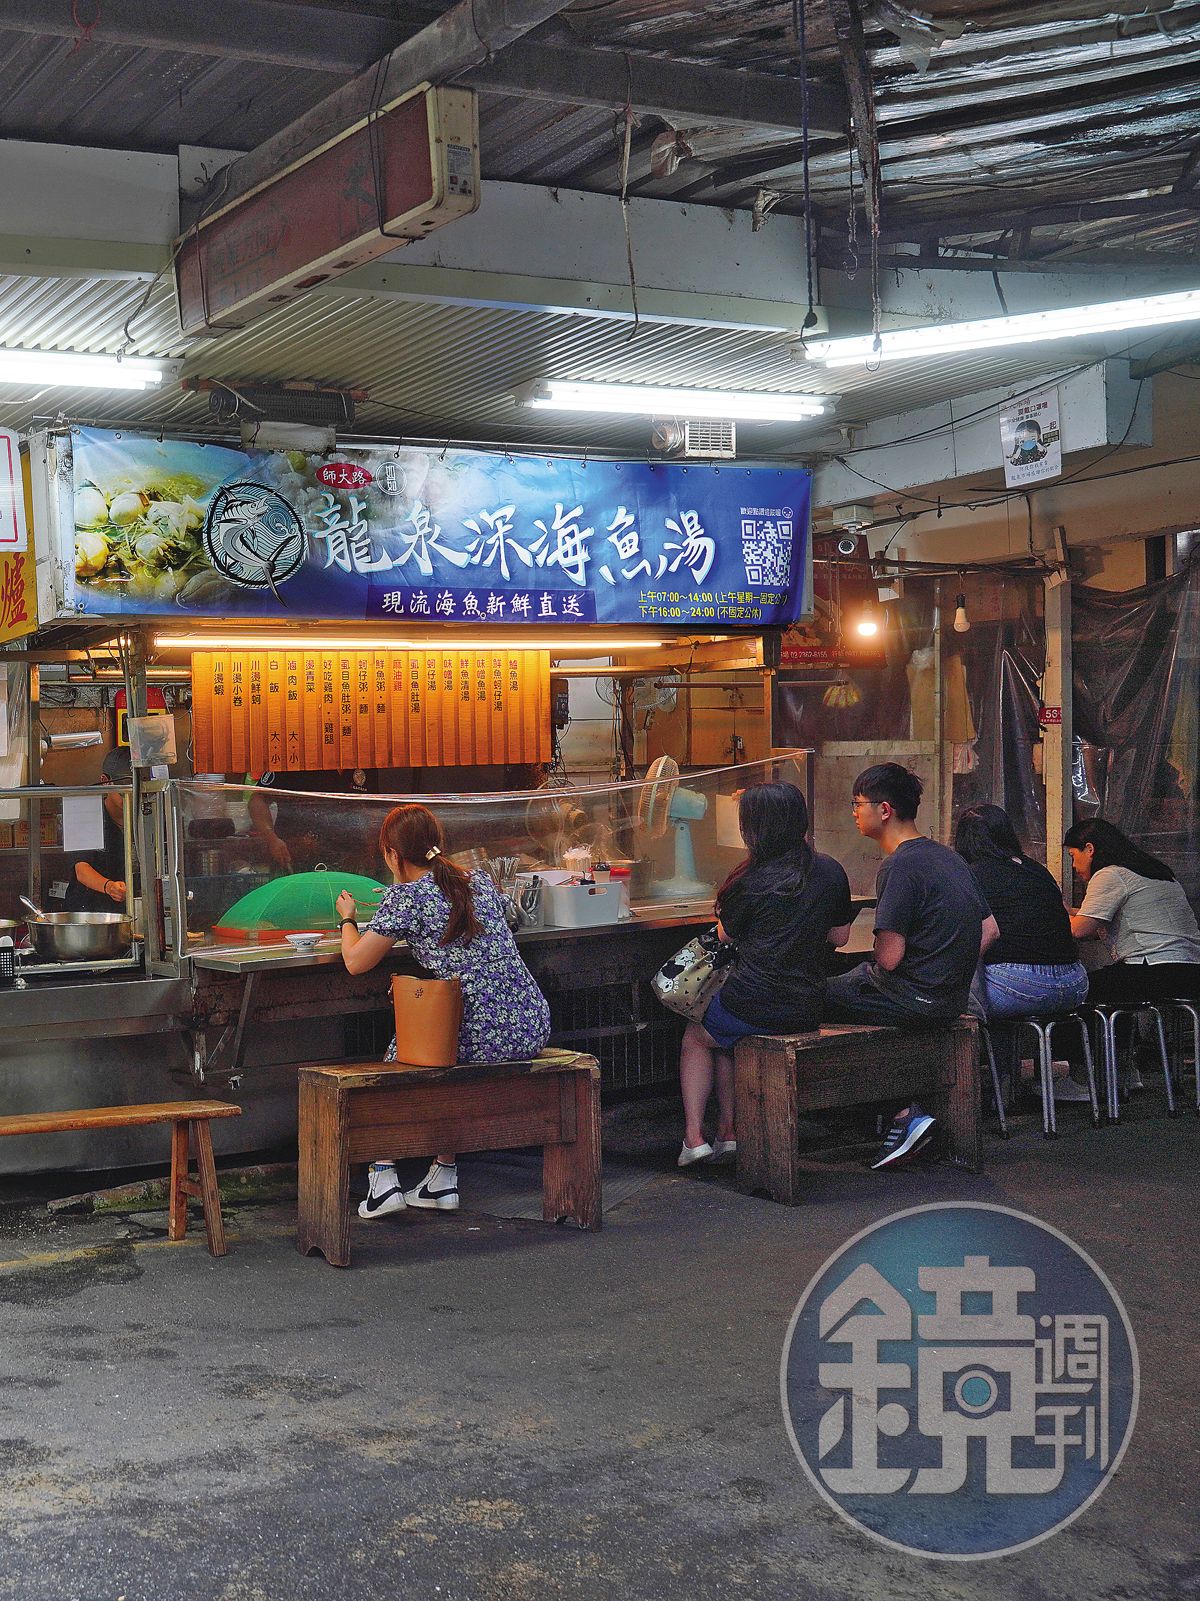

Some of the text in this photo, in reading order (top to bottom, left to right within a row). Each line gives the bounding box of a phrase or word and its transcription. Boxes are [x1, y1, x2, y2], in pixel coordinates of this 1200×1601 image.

[322, 468, 367, 485] 師大路
[312, 491, 716, 586] 龍泉深海魚湯
[381, 589, 585, 617] 現流海魚新鮮直送
[214, 661, 225, 696] 川燙蝦
[232, 661, 243, 707] 川燙小卷
[250, 660, 261, 705] 川燙鮮蚵
[269, 660, 279, 693] 白飯
[287, 660, 298, 700] 滷肉飯
[305, 660, 315, 693] 燙青菜
[392, 659, 402, 692] 麻油雞
[427, 659, 437, 691] 蚵仔湯
[460, 659, 470, 701] 鮮魚清湯
